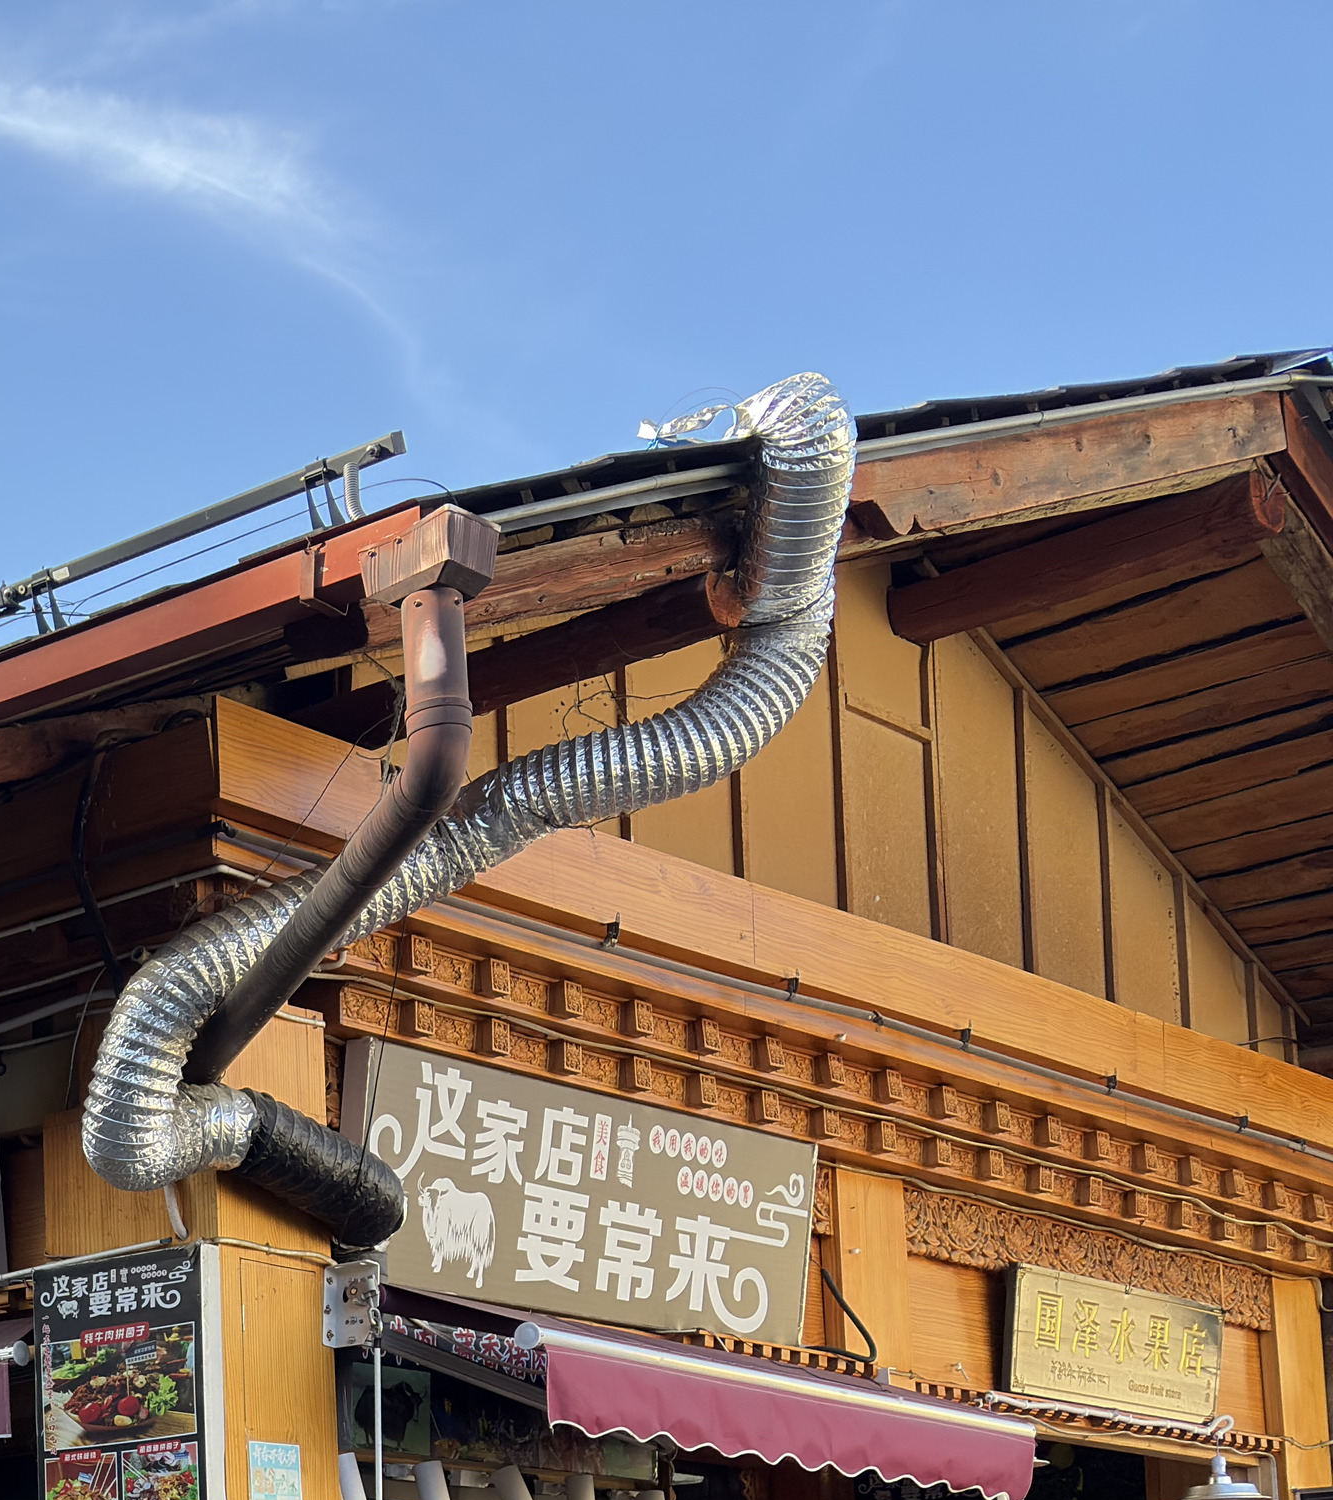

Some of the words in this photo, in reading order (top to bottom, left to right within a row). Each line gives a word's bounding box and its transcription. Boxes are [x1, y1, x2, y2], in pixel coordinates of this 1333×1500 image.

[373, 1062, 589, 1186] 这家店
[594, 1120, 609, 1176] 美食
[651, 1128, 726, 1165] 我用我的味
[679, 1170, 751, 1206] 温暖你的胃
[516, 1182, 766, 1330] 要常来
[42, 1272, 109, 1304] 这家店
[89, 1283, 179, 1318] 要常来
[84, 1325, 146, 1344] 牦牛肉拼菌子
[1034, 1290, 1208, 1378] 国泽水果店
[1128, 1380, 1149, 1394] Guoze
[1150, 1383, 1164, 1397] fruit
